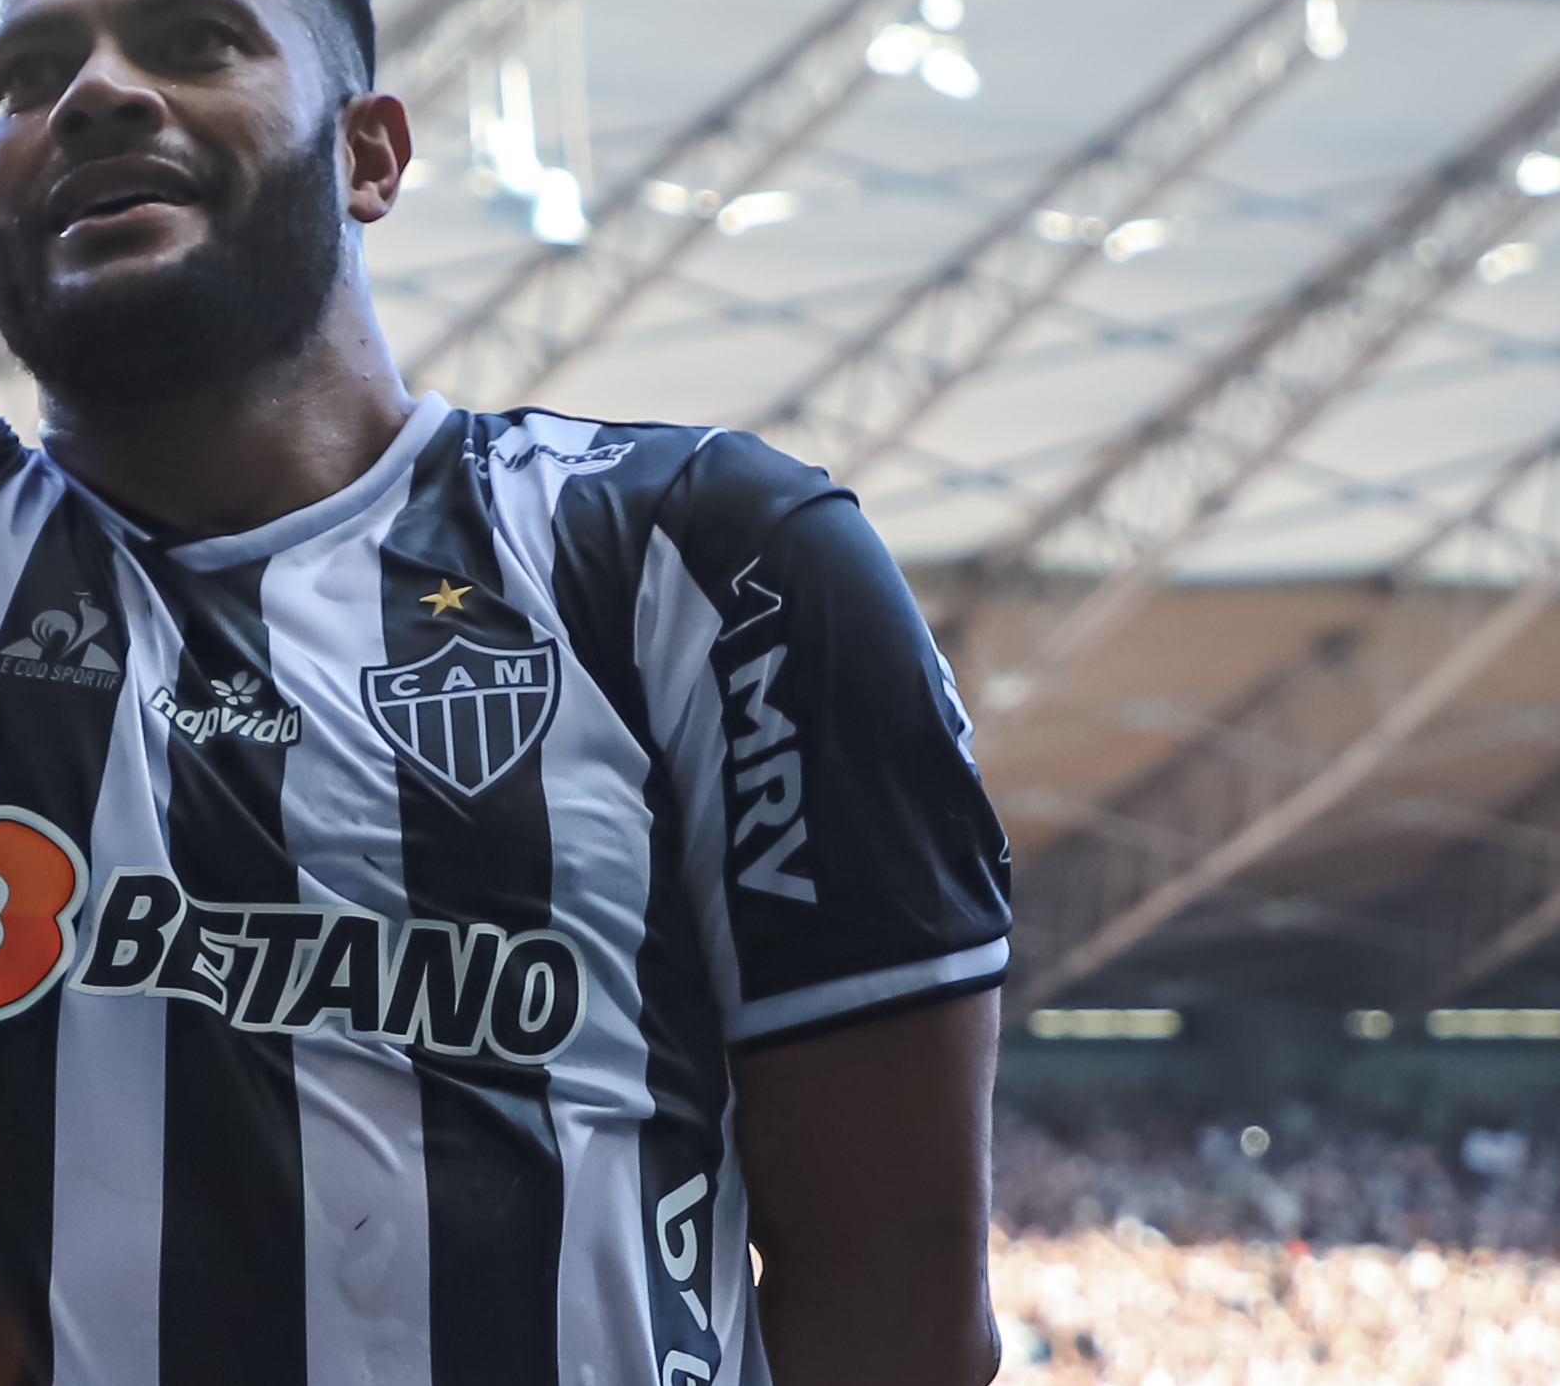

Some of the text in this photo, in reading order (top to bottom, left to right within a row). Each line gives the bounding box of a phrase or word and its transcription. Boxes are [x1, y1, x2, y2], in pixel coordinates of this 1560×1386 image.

[50, 663, 119, 690] SPORTIF
[149, 686, 301, 746] hapvida
[729, 644, 818, 904] MRV
[74, 870, 584, 1061] BETANO
